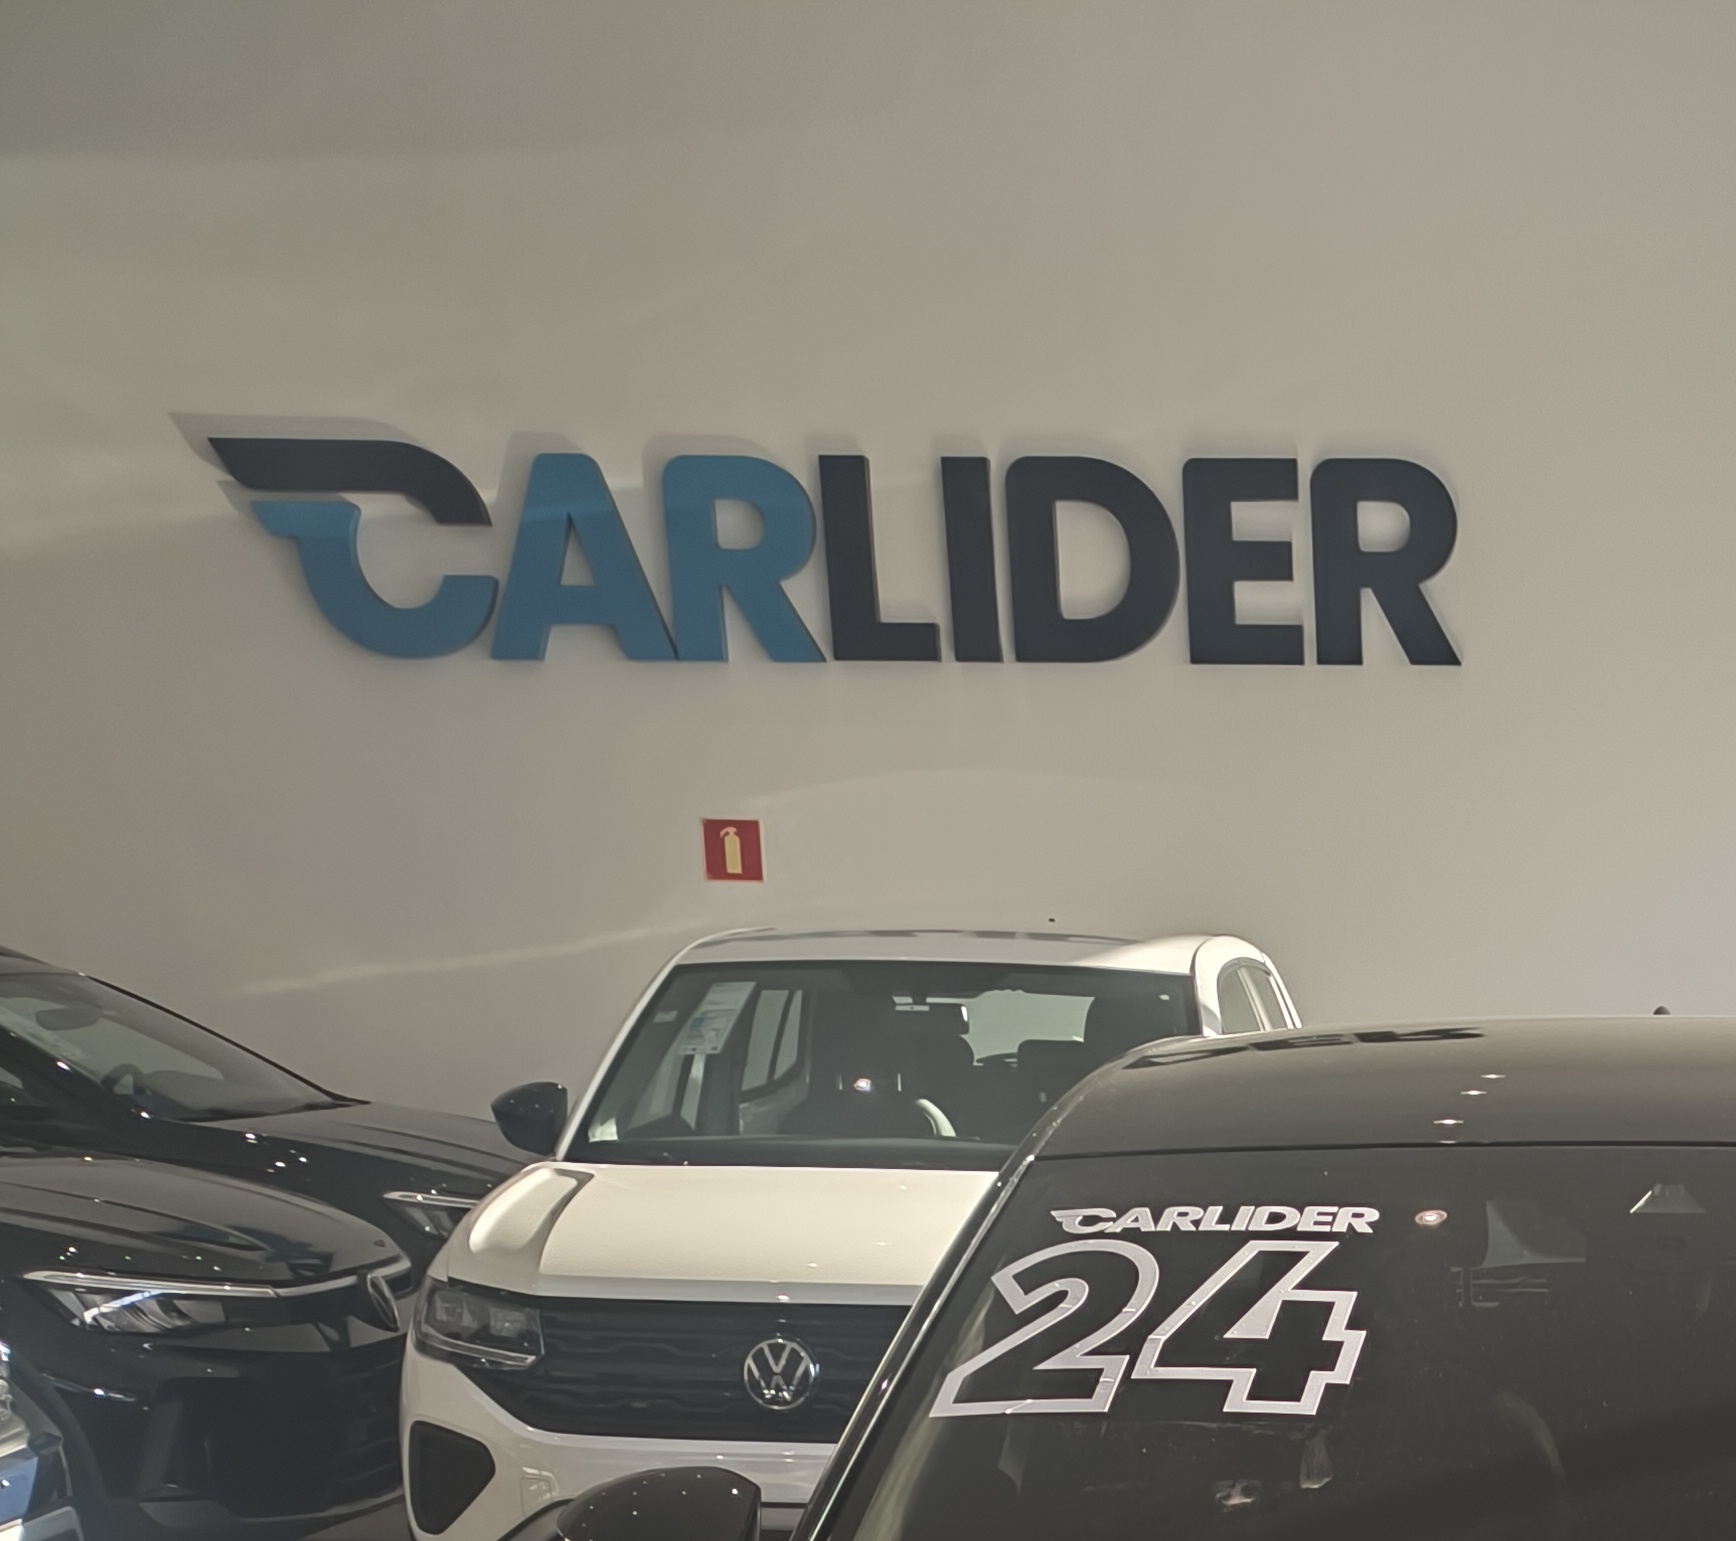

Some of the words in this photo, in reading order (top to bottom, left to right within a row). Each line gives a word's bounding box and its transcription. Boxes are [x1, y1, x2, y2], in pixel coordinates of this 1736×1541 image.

[207, 437, 1461, 665] CARLIDER
[1050, 1206, 1379, 1233] CARLIDER
[929, 1239, 1366, 1417] 24
